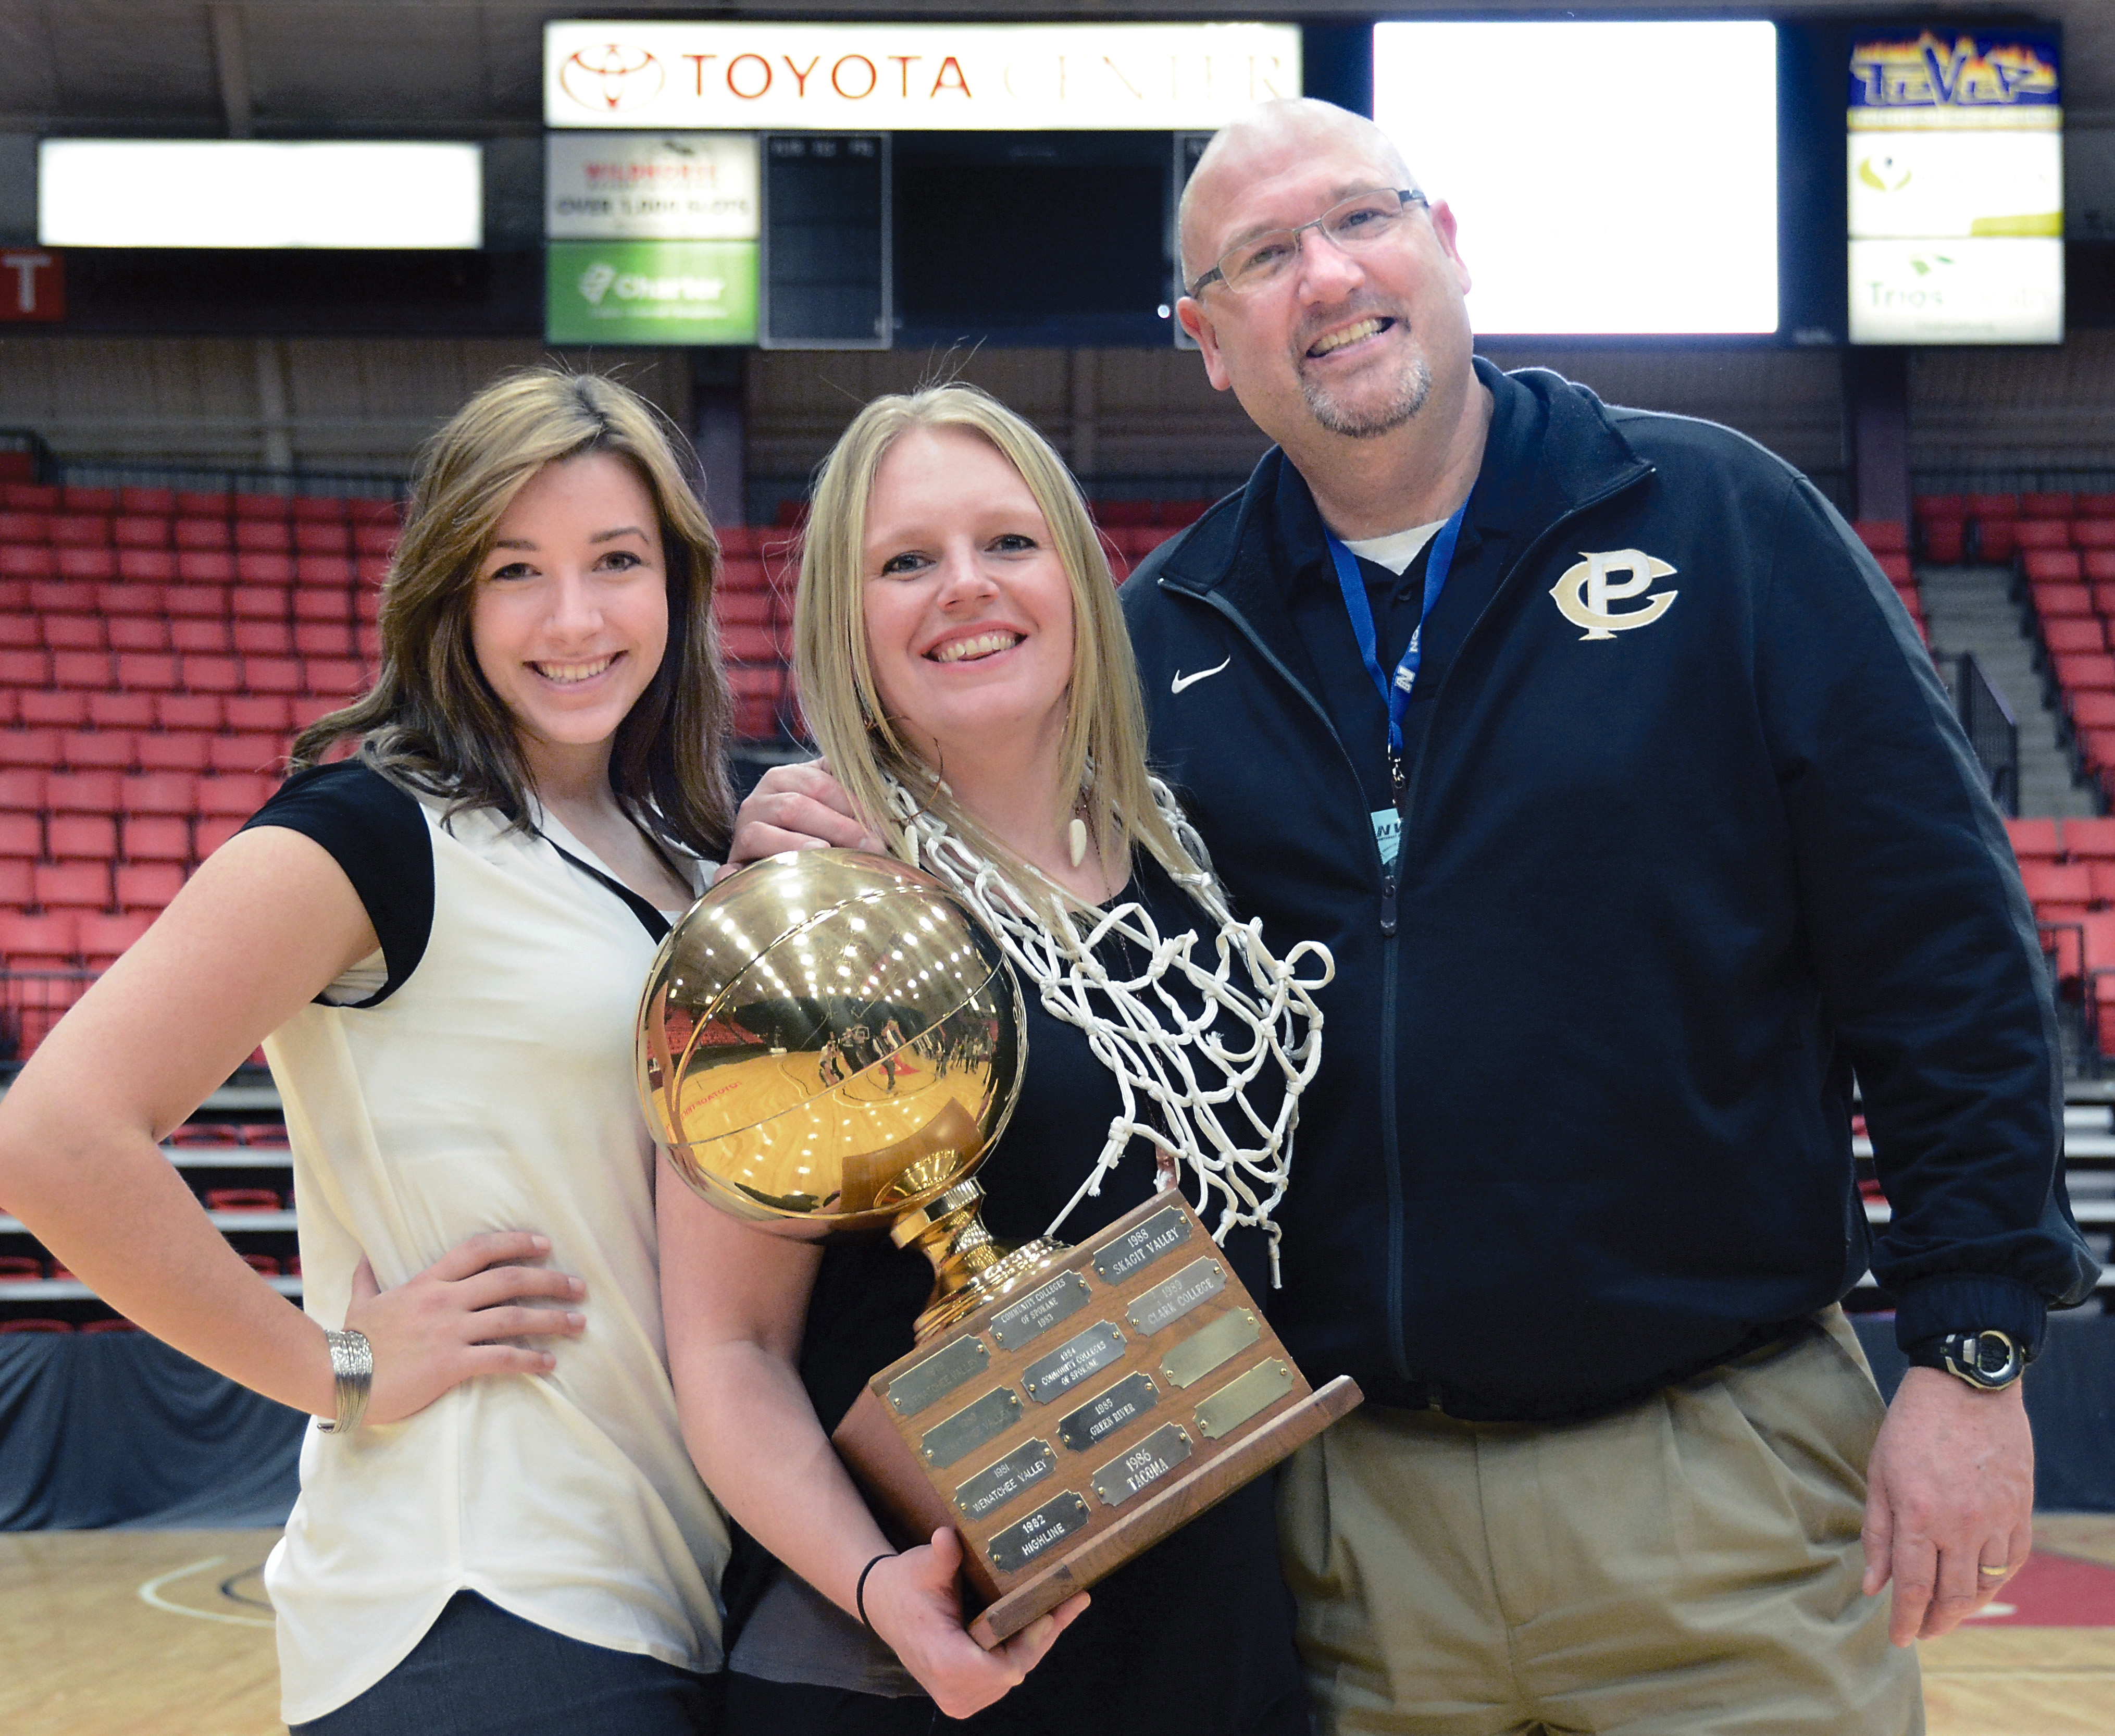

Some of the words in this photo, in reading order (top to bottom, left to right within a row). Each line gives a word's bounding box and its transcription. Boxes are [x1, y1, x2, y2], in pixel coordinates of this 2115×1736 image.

[682, 54, 972, 98] TOYOTA
[2, 256, 52, 314] T
[1113, 1248, 1146, 1275] SKAGIT
[1147, 1227, 1179, 1254] VALLEY
[1127, 1228, 1149, 1248] 1988
[1001, 1297, 1036, 1323] COMMUNITY
[1035, 1278, 1066, 1301] COLLEGES
[1021, 1313, 1030, 1325] OF
[1030, 1297, 1059, 1320] SPOKANE
[1147, 1301, 1177, 1325] CLARK
[1177, 1278, 1214, 1306] COLLEGE
[1037, 1313, 1054, 1328] 1983
[1041, 1359, 1076, 1385] COMMUNITY
[1076, 1341, 1106, 1364] COLLEGES
[1060, 1348, 1076, 1361] 1984
[1061, 1376, 1070, 1386] OF
[1070, 1359, 1099, 1380] SPOKANE
[1089, 1416, 1114, 1436] GREEN
[1113, 1403, 1136, 1423] RIVER
[1094, 1398, 1113, 1415] 1985
[993, 1463, 1010, 1478] 1981
[1125, 1448, 1152, 1472] 1986
[1126, 1458, 1169, 1491] TACOMA
[972, 1479, 1017, 1512] WENATCHEE
[1017, 1459, 1047, 1482] VALLEY
[1022, 1514, 1046, 1534] 1982
[1022, 1522, 1065, 1556] HIGHLINE
